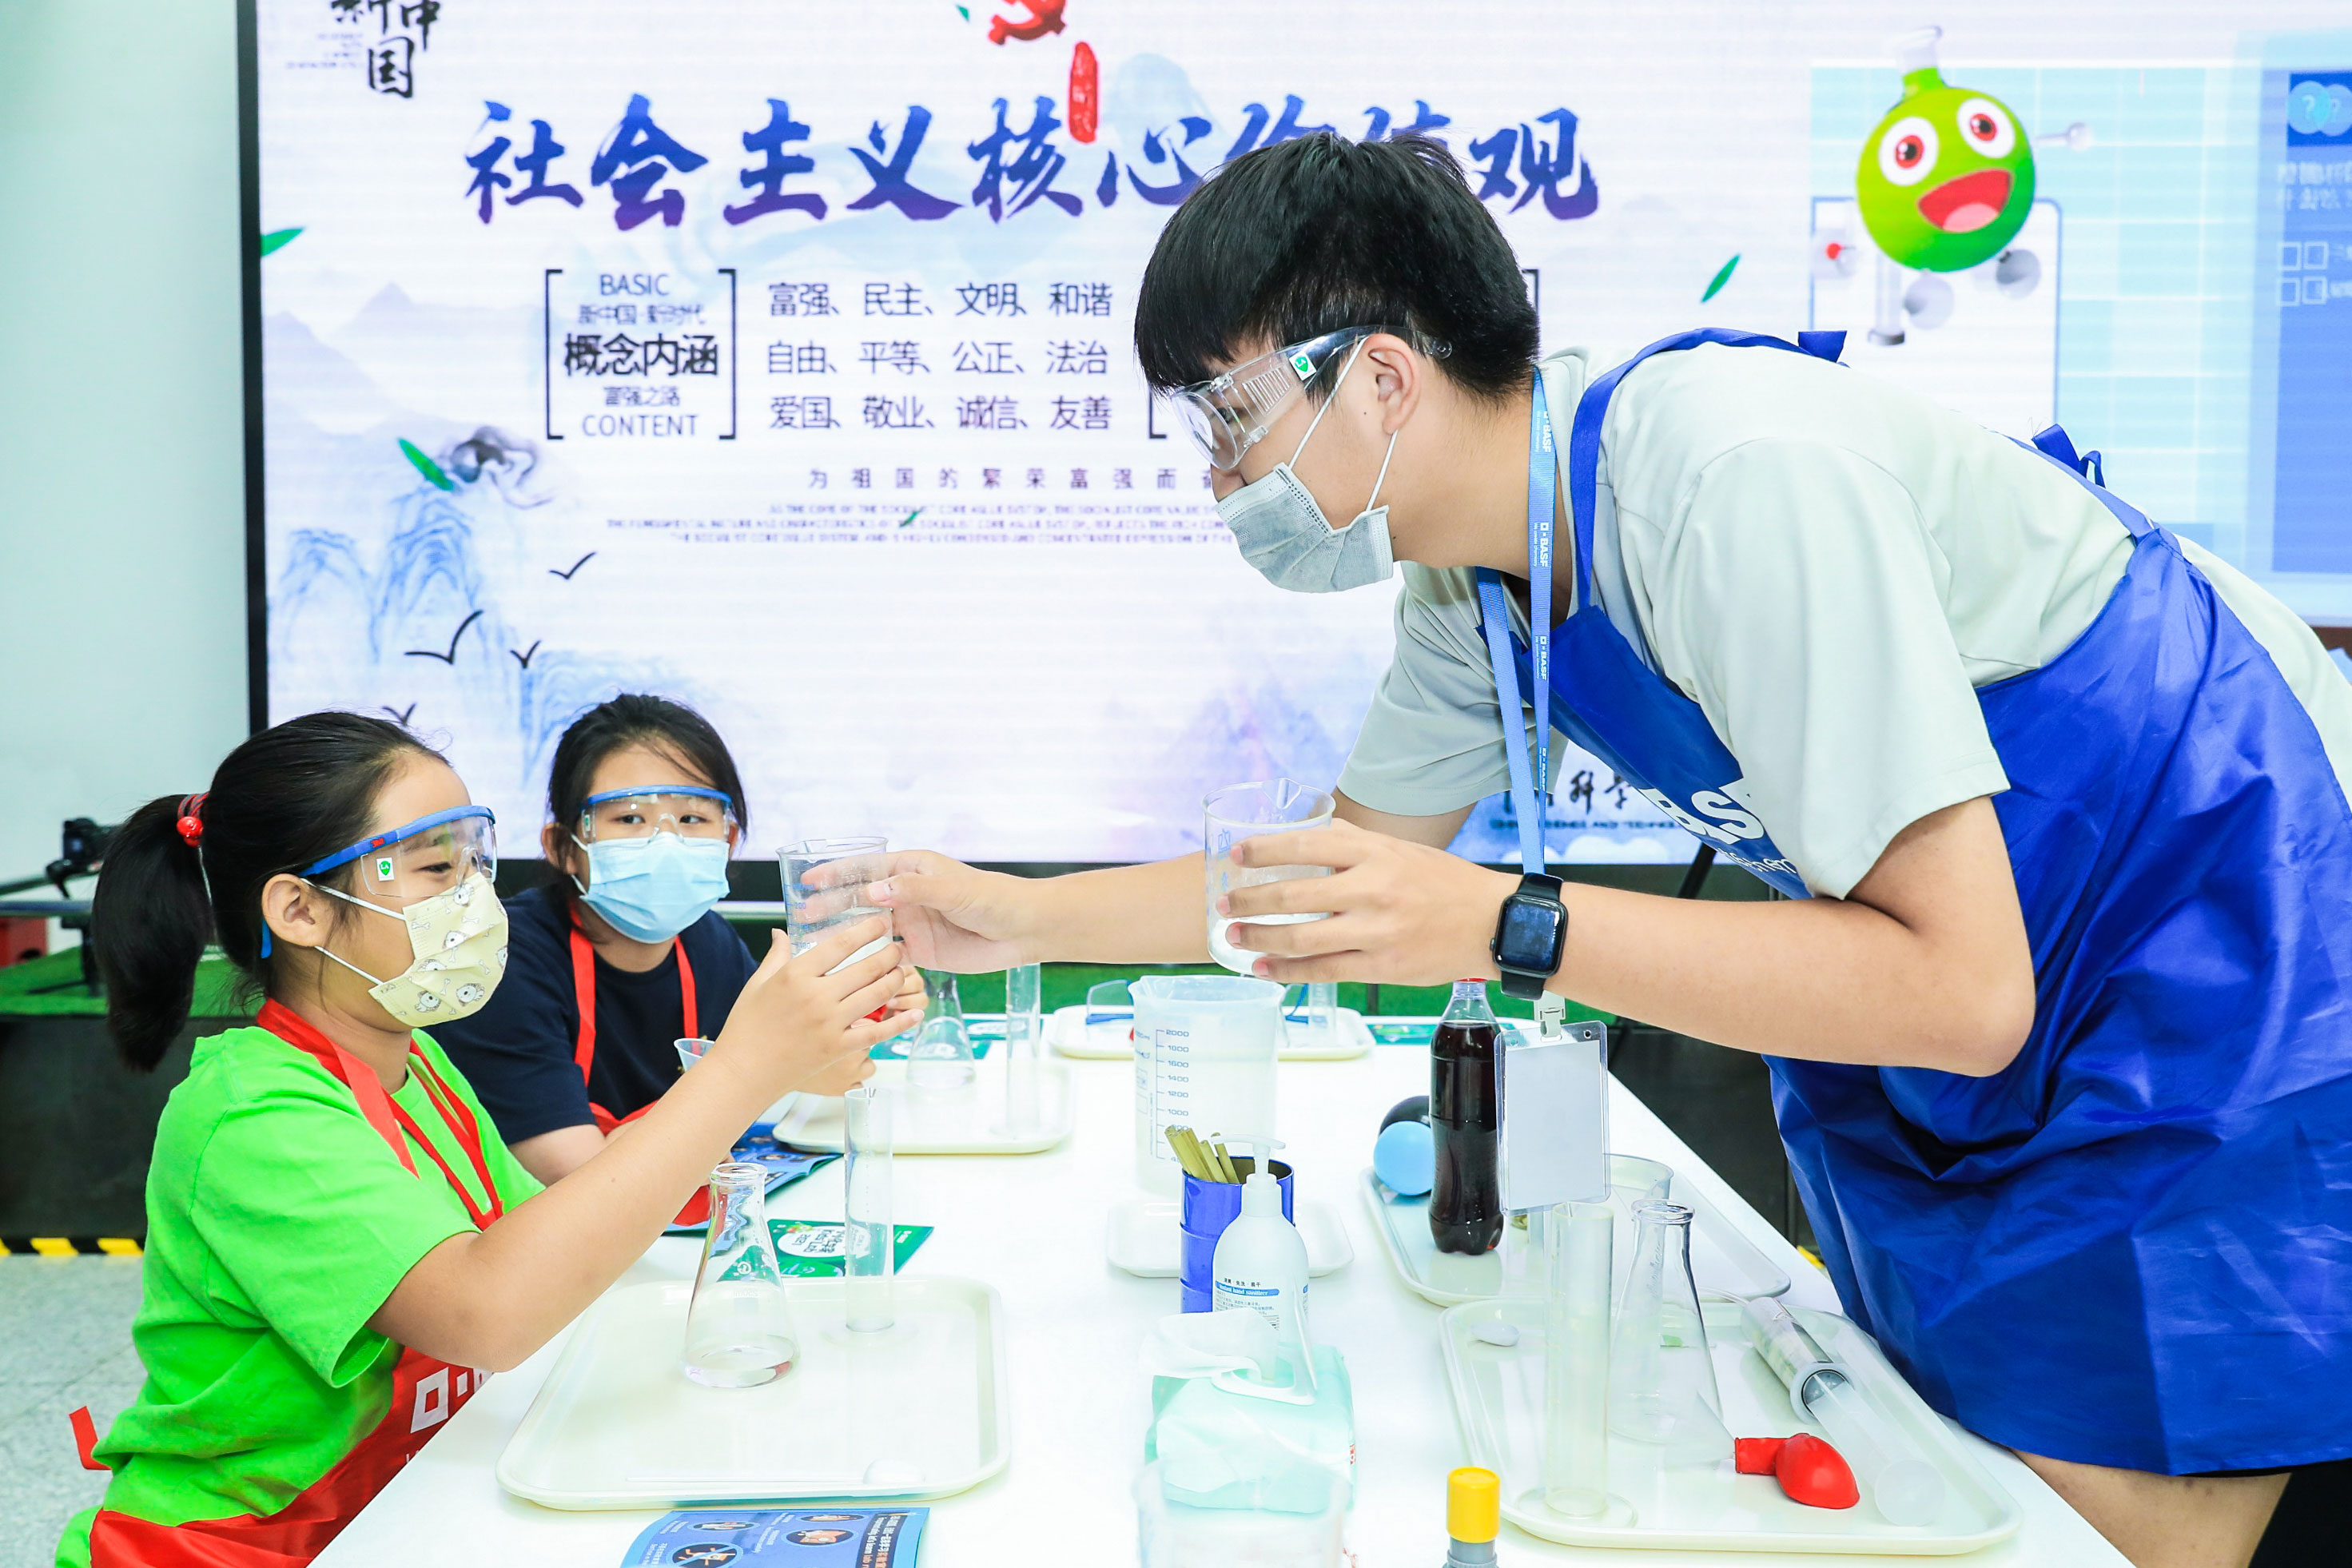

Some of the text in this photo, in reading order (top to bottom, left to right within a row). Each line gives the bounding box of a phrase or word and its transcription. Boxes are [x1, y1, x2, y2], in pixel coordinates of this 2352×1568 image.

[465, 93, 1599, 230] 社会主义核心观
[599, 274, 670, 296] BASIC
[564, 333, 718, 376] 概念内涵
[603, 386, 680, 407] 富强之路
[582, 415, 698, 436] CONTENT
[1542, 425, 1551, 453] BASF
[1540, 538, 1549, 567] BASF
